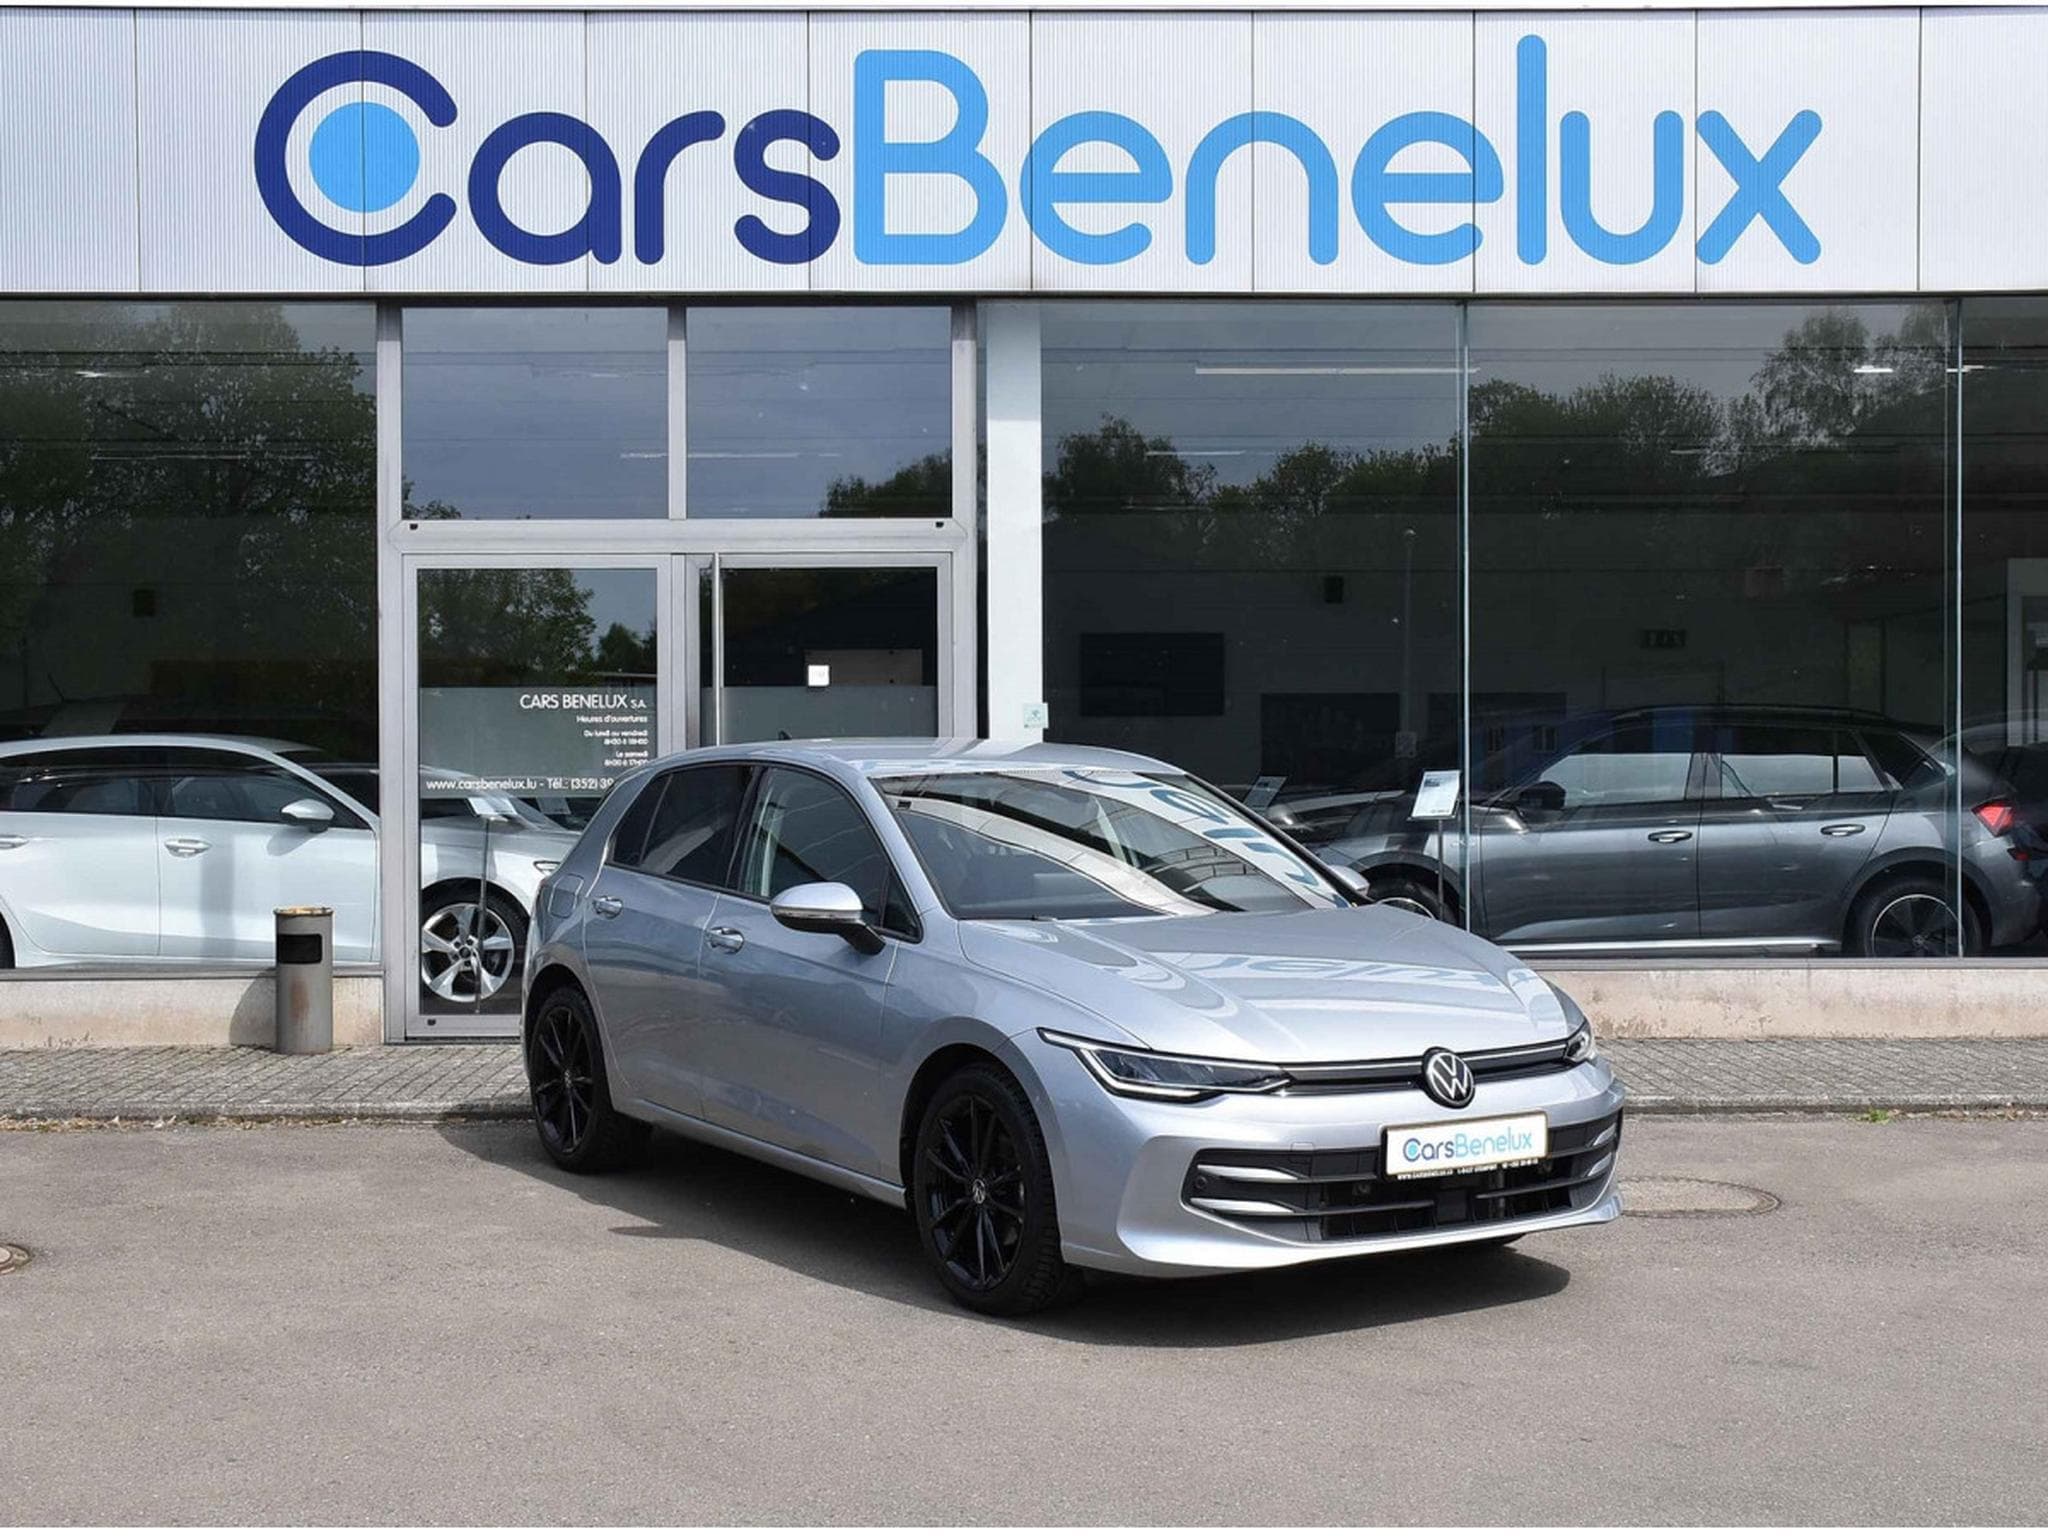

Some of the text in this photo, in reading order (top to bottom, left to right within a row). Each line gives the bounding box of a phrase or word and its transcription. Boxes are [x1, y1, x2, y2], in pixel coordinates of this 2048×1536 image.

[254, 35, 1822, 266] CarsBenelux
[520, 694, 559, 709] CARS
[562, 694, 628, 709] BENELUX
[576, 715, 603, 723] Heures
[426, 778, 537, 790] www.carsbenelux.lu
[570, 778, 598, 790] (352)
[1402, 1126, 1533, 1163] CarsBenelux
